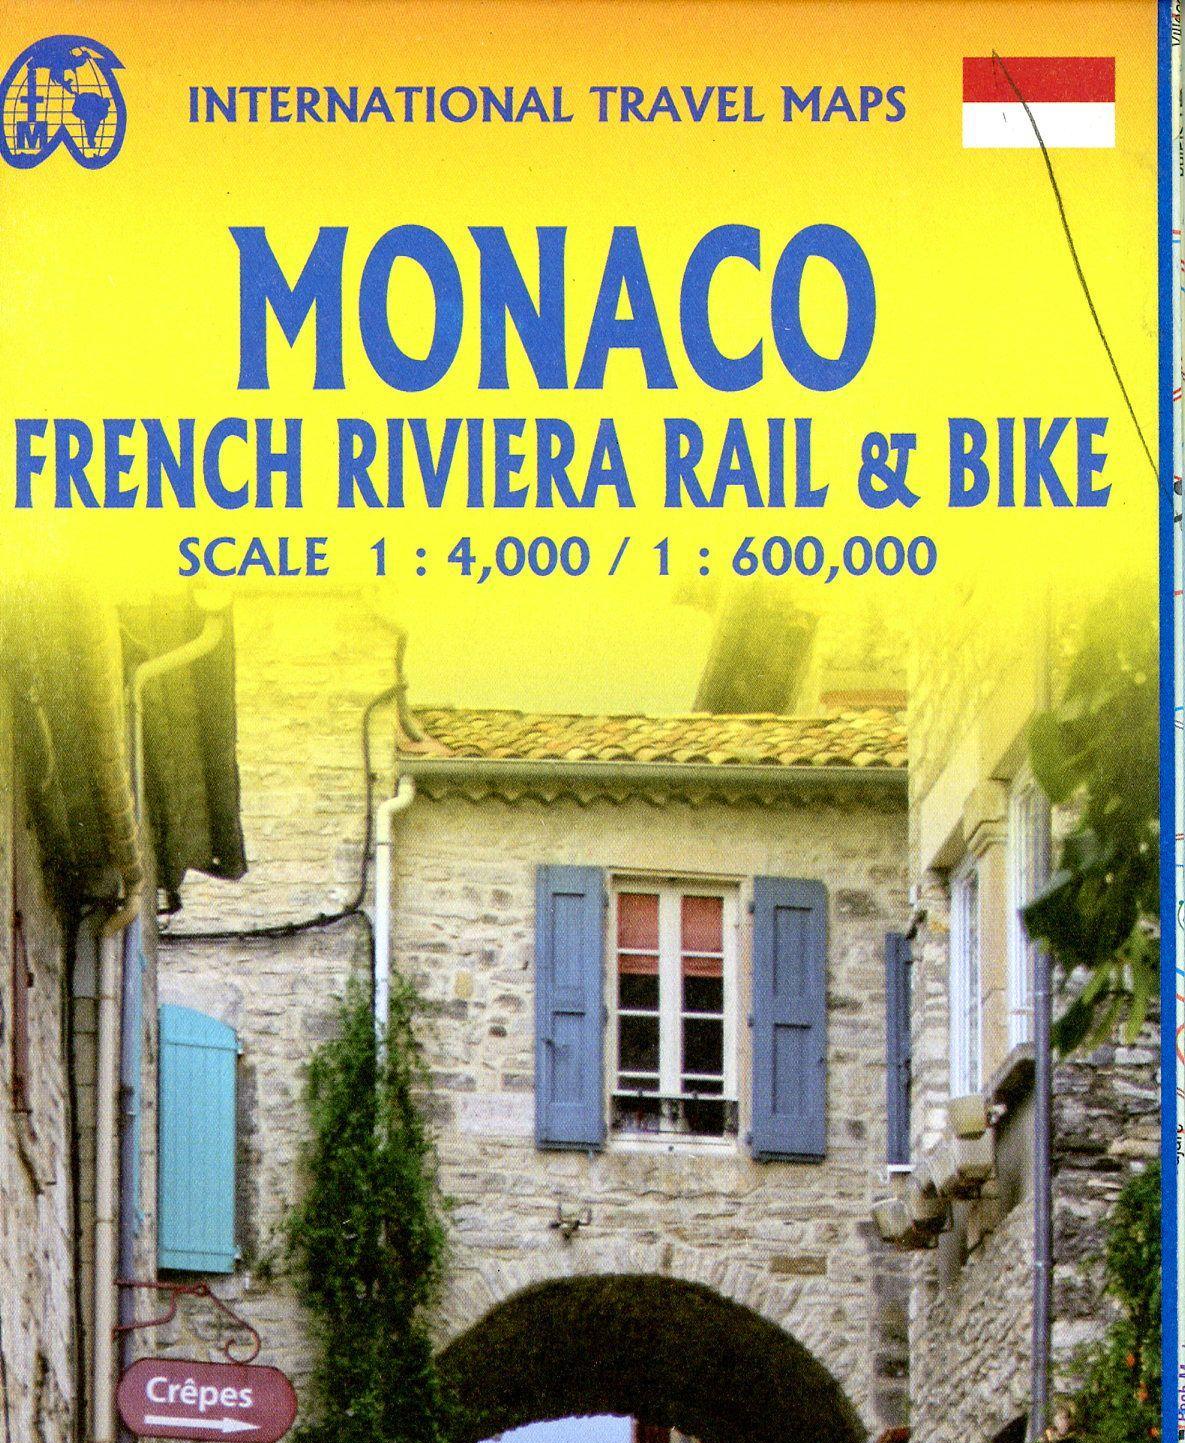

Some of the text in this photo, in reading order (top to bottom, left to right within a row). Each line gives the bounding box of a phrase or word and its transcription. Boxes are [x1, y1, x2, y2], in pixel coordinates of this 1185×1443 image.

[188, 85, 907, 124] INTERNATIONAL TRAVEL MAPS
[228, 222, 877, 393] MONACO
[14, 416, 1112, 511] FRENCH RIVIERA RAIL & BIKE
[178, 536, 330, 578] SCALE
[368, 539, 388, 577] 1
[448, 536, 591, 583] 4,000
[652, 539, 671, 577] 1
[731, 535, 939, 584] 600,000
[145, 1376, 254, 1413] Crêpes
